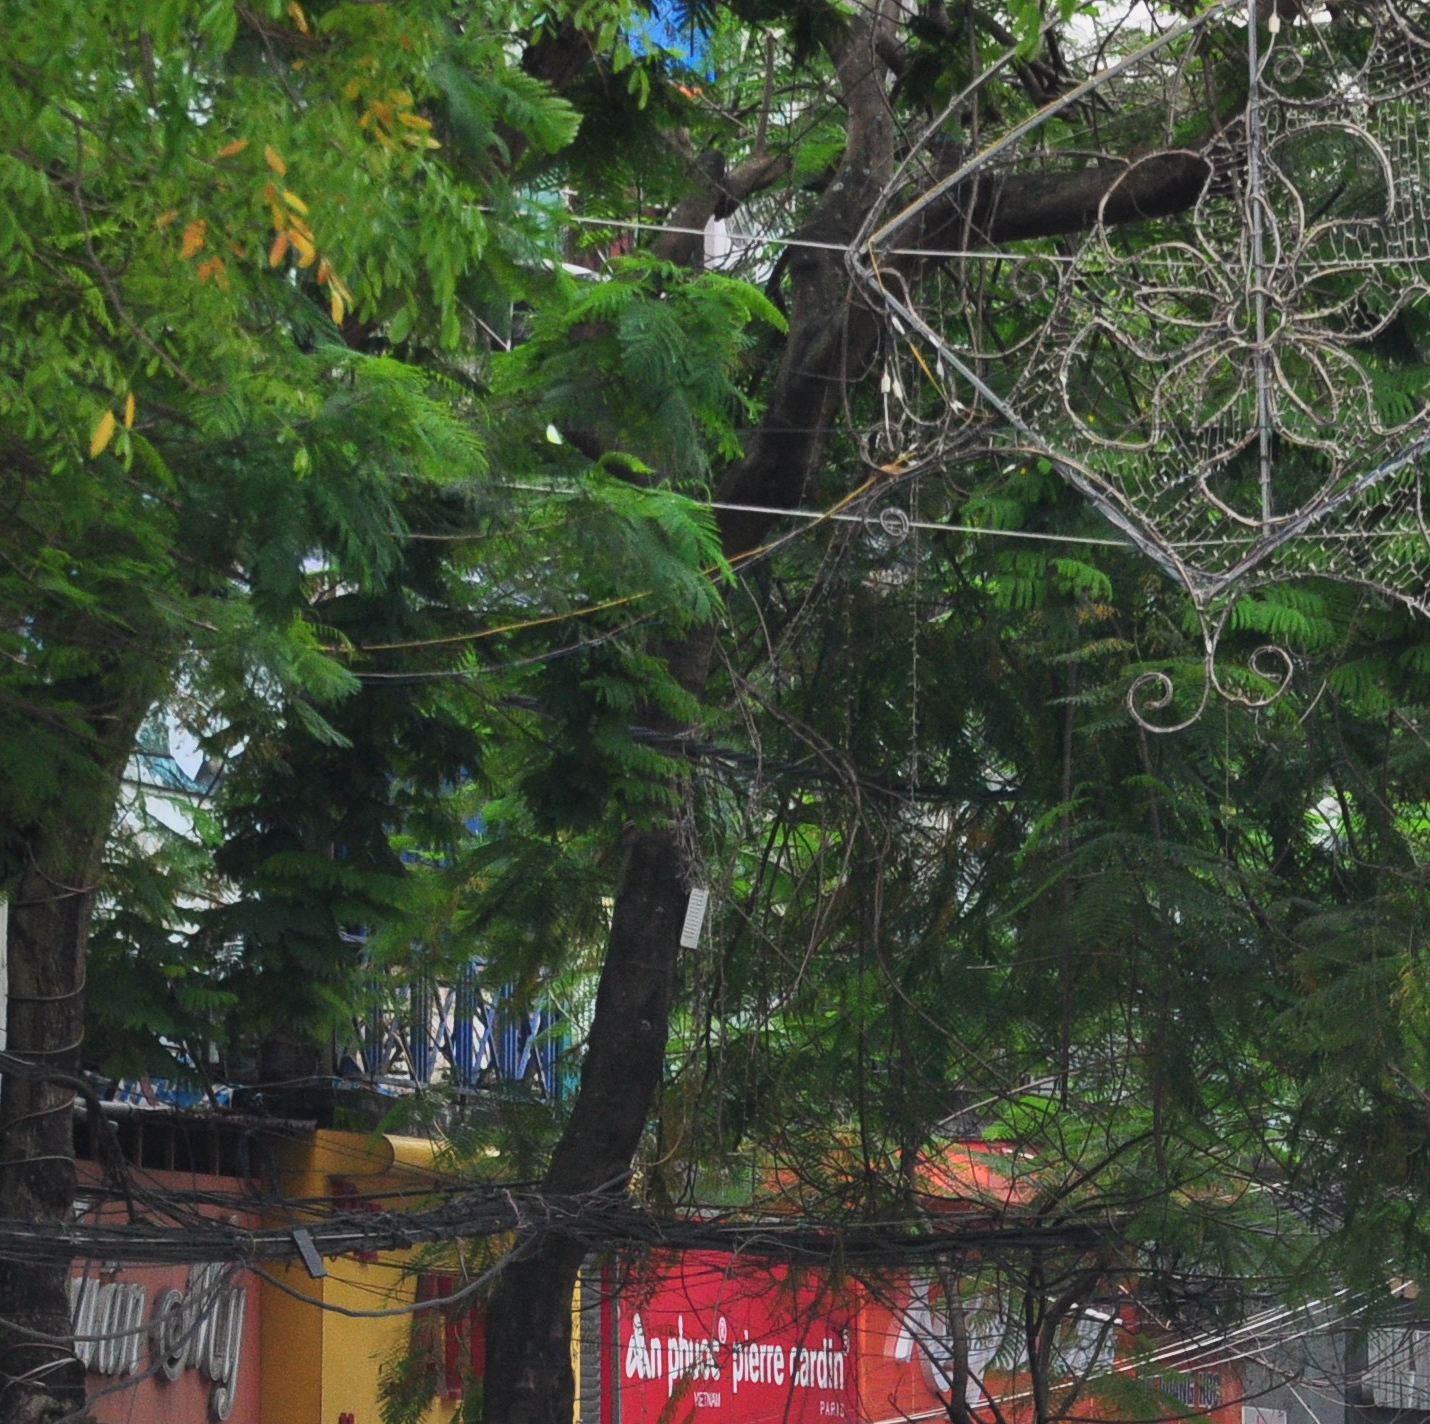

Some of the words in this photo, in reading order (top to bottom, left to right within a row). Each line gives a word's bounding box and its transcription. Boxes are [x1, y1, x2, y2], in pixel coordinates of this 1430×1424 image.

[732, 1330, 785, 1393] pierre
[789, 1338, 844, 1390] cardin
[819, 1400, 846, 1417] PARIS
